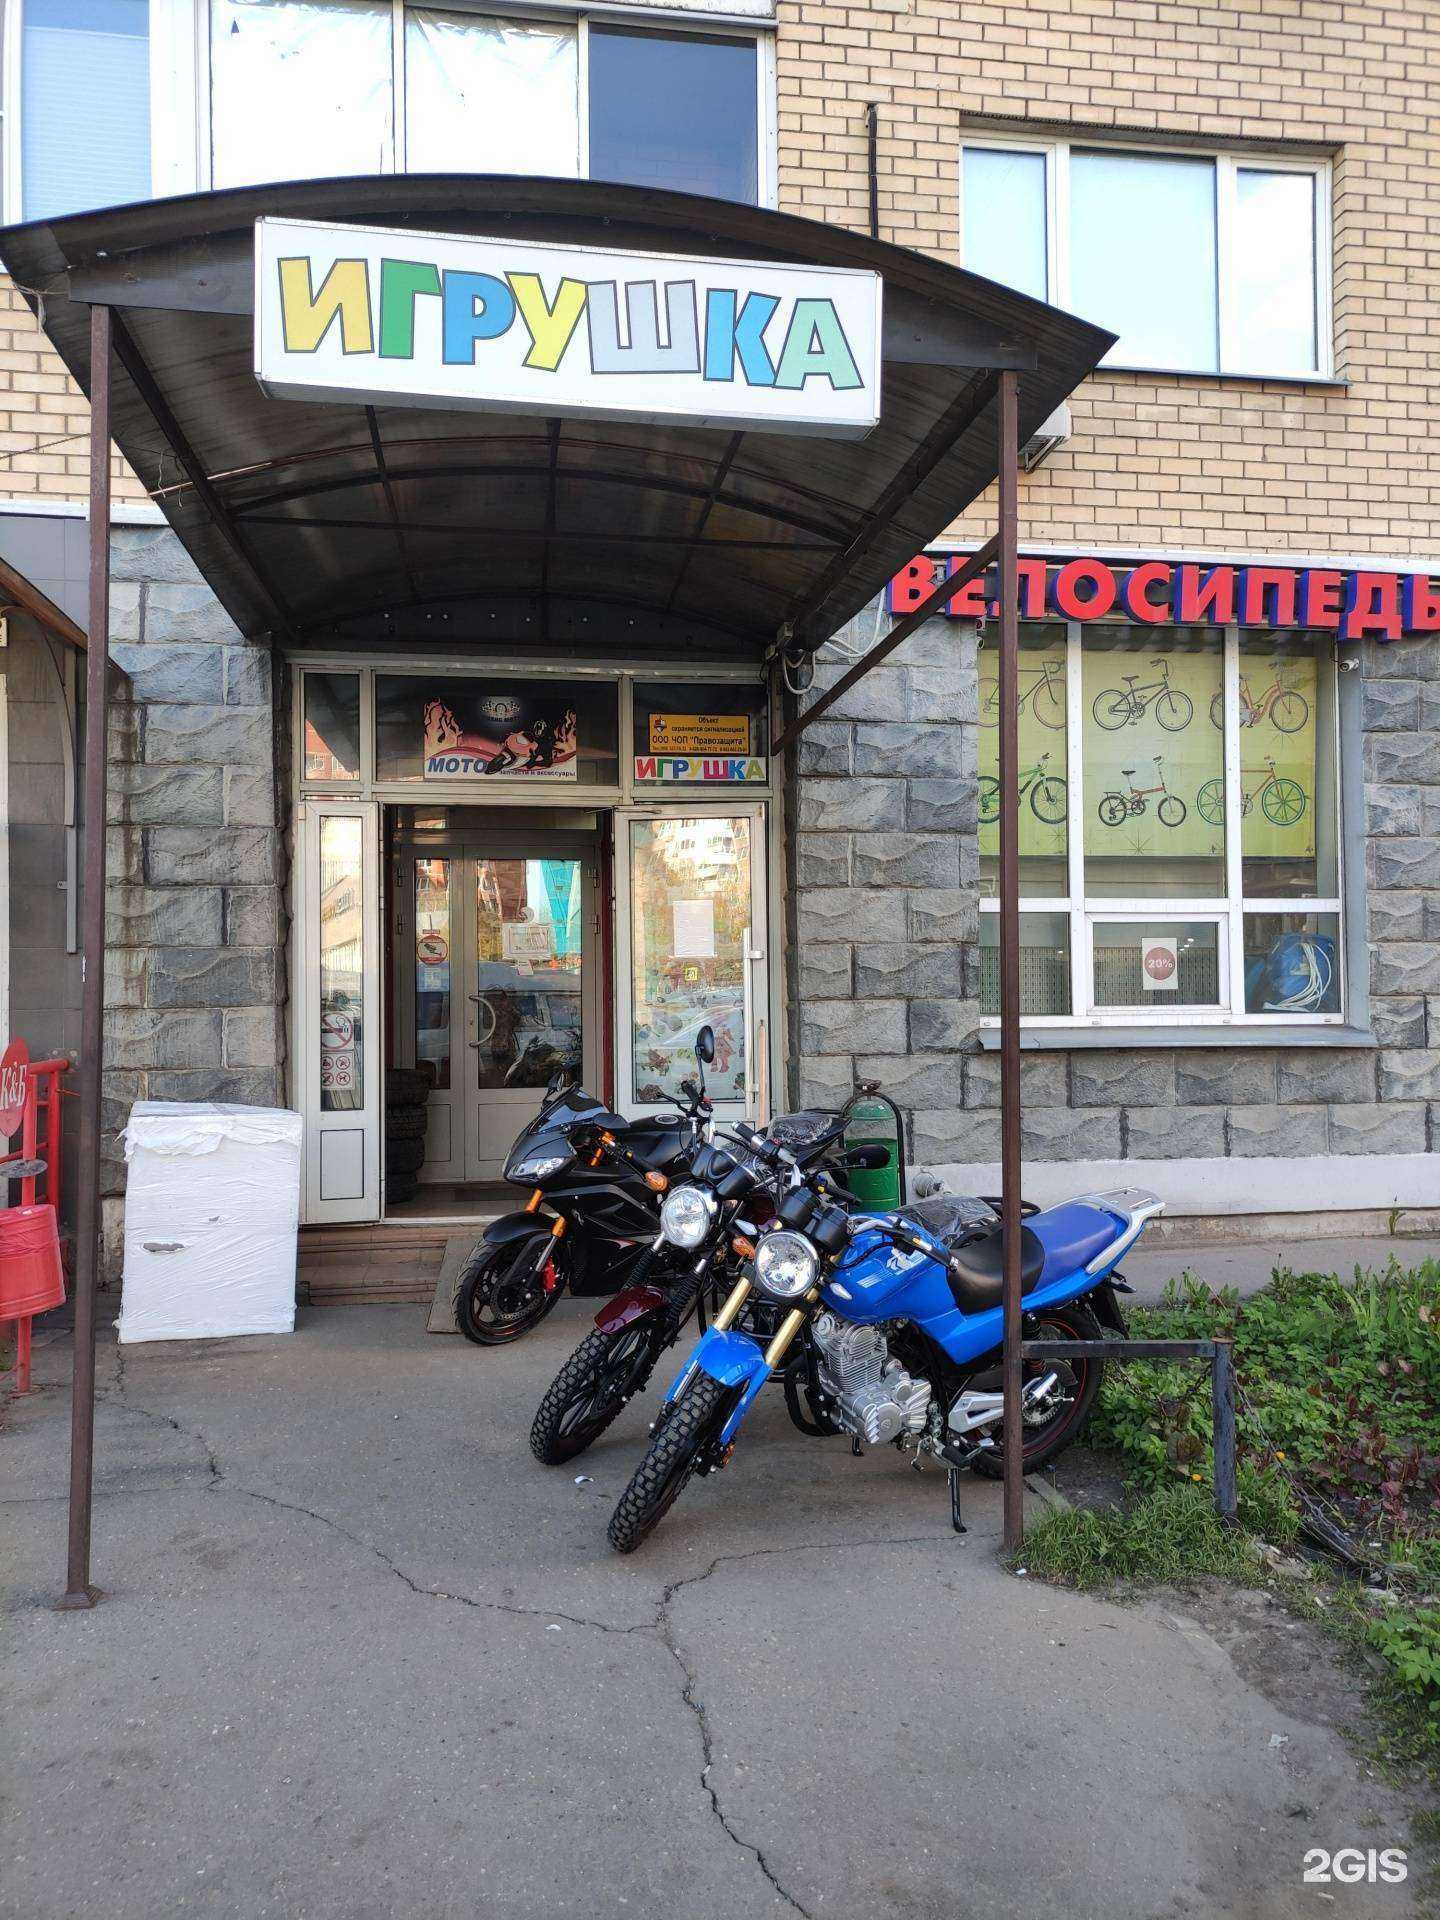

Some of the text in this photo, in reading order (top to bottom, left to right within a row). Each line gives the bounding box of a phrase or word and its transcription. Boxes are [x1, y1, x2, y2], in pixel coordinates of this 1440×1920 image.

[277, 256, 865, 391] ИГРУШКА
[652, 735, 669, 743] ООО
[672, 735, 688, 744] ЧОП
[428, 757, 487, 774] МОТО
[636, 757, 765, 780] ИГРУШКА
